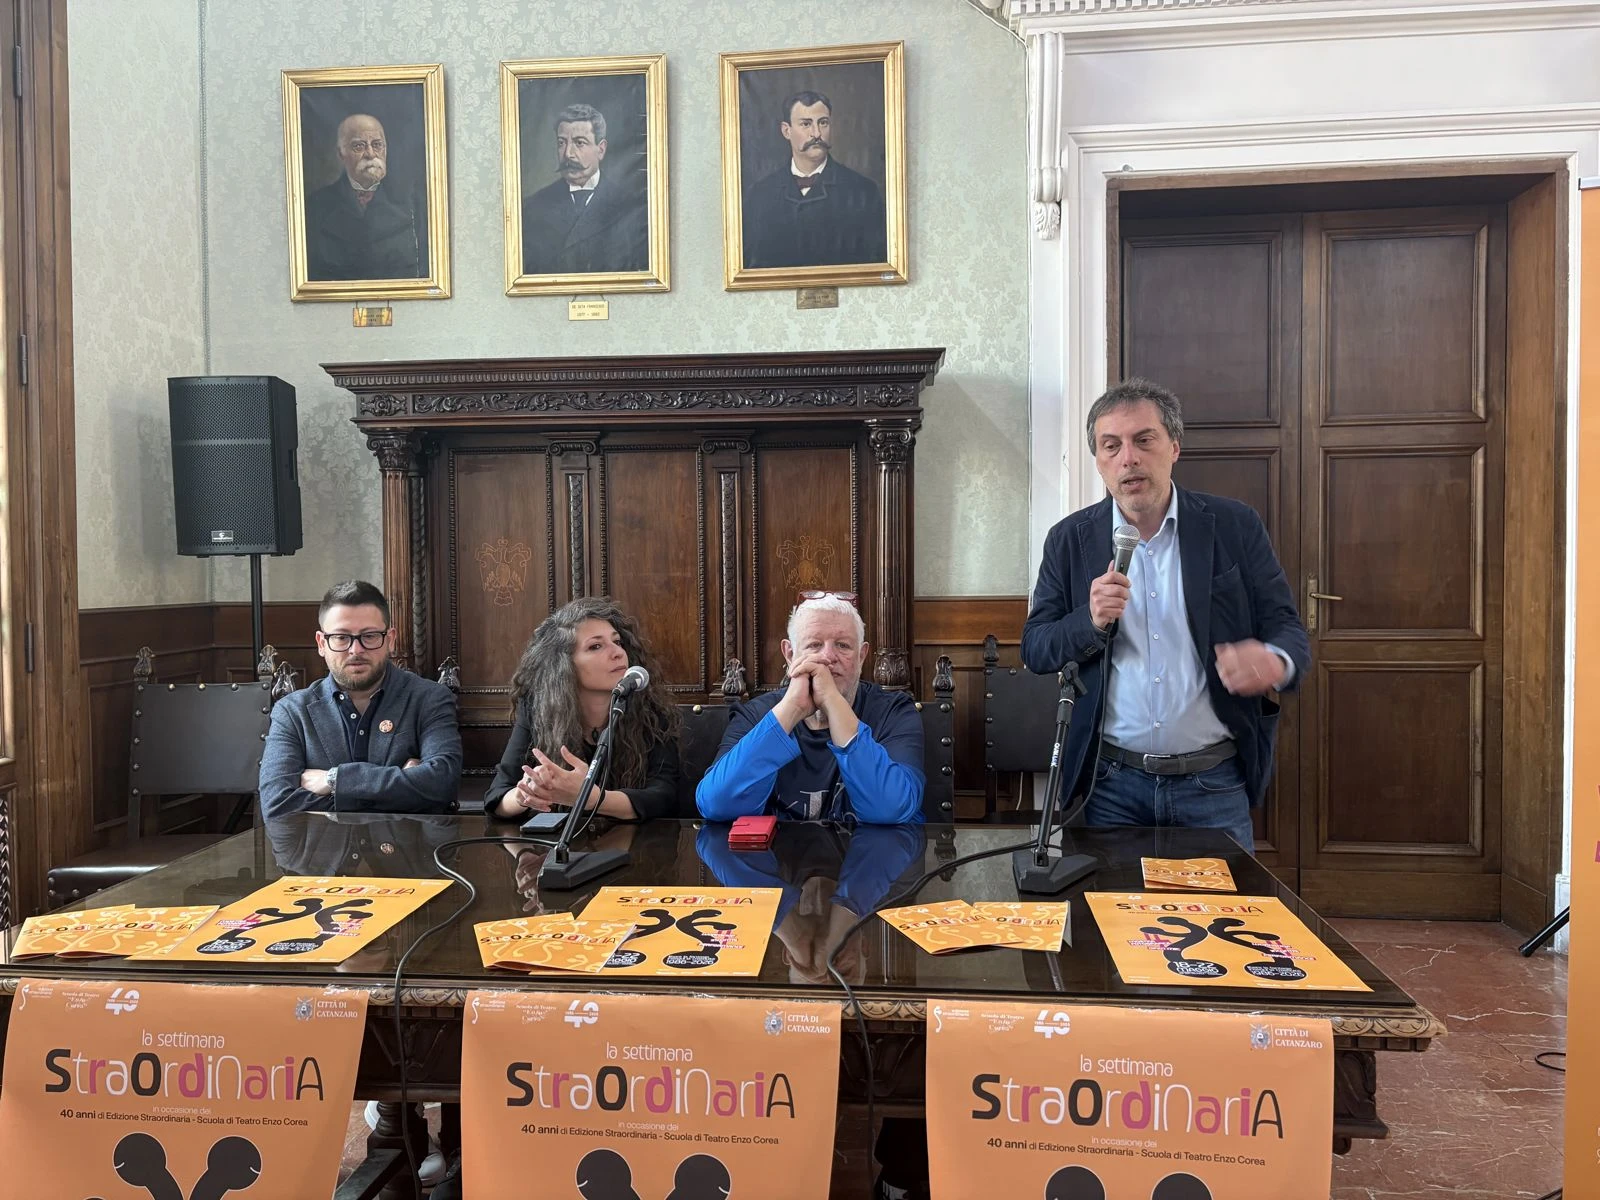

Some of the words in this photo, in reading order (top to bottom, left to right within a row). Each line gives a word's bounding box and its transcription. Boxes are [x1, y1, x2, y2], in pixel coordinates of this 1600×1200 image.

[105, 987, 140, 1015] 40
[339, 1001, 347, 1009] DI
[316, 1010, 358, 1018] CATANZARO
[564, 1000, 599, 1028] 40
[810, 1015, 819, 1023] DI
[787, 1025, 831, 1034] CATANZARO
[1034, 1010, 1070, 1039] 40
[1299, 1029, 1309, 1037] DI
[142, 1029, 153, 1046] la
[157, 1032, 225, 1049] settimana
[1275, 1039, 1323, 1049] CATANZARO
[606, 1042, 617, 1060] la
[622, 1044, 693, 1062] settimana
[45, 1048, 324, 1101] StraOrdinariA
[1080, 1054, 1092, 1072] la
[1098, 1057, 1173, 1077] settimana
[507, 1062, 795, 1118] StraOrdinariA
[972, 1073, 1284, 1139] StraOrdinariA
[60, 1109, 74, 1119] 40
[75, 1110, 96, 1119] anni
[106, 1112, 139, 1121] Edizione
[140, 1113, 191, 1123] Straordinaria
[197, 1115, 225, 1125] Scuola
[226, 1116, 234, 1125] di
[236, 1116, 261, 1125] Teatro
[262, 1117, 282, 1126] Enzo
[283, 1117, 308, 1126] Corea
[521, 1124, 535, 1134] 40
[537, 1125, 559, 1135] anni
[560, 1127, 568, 1135] di
[569, 1127, 604, 1137] Edizione
[605, 1129, 657, 1140] Straordinaria
[664, 1132, 693, 1141] Scuola
[694, 1132, 702, 1141] di
[703, 1133, 730, 1143] Teatro
[731, 1135, 752, 1144] Enzo
[753, 1135, 779, 1145] Corea
[987, 1138, 1002, 1148] 40
[1004, 1139, 1027, 1149] anni
[1028, 1142, 1037, 1150] di
[1038, 1143, 1075, 1153] Edizione
[1077, 1145, 1134, 1157] Straordinaria
[1141, 1149, 1172, 1160] Scuola
[1173, 1151, 1182, 1160] di
[1184, 1152, 1212, 1162] Teatro
[1213, 1154, 1236, 1164] Enzo
[1237, 1156, 1265, 1166] Corea
